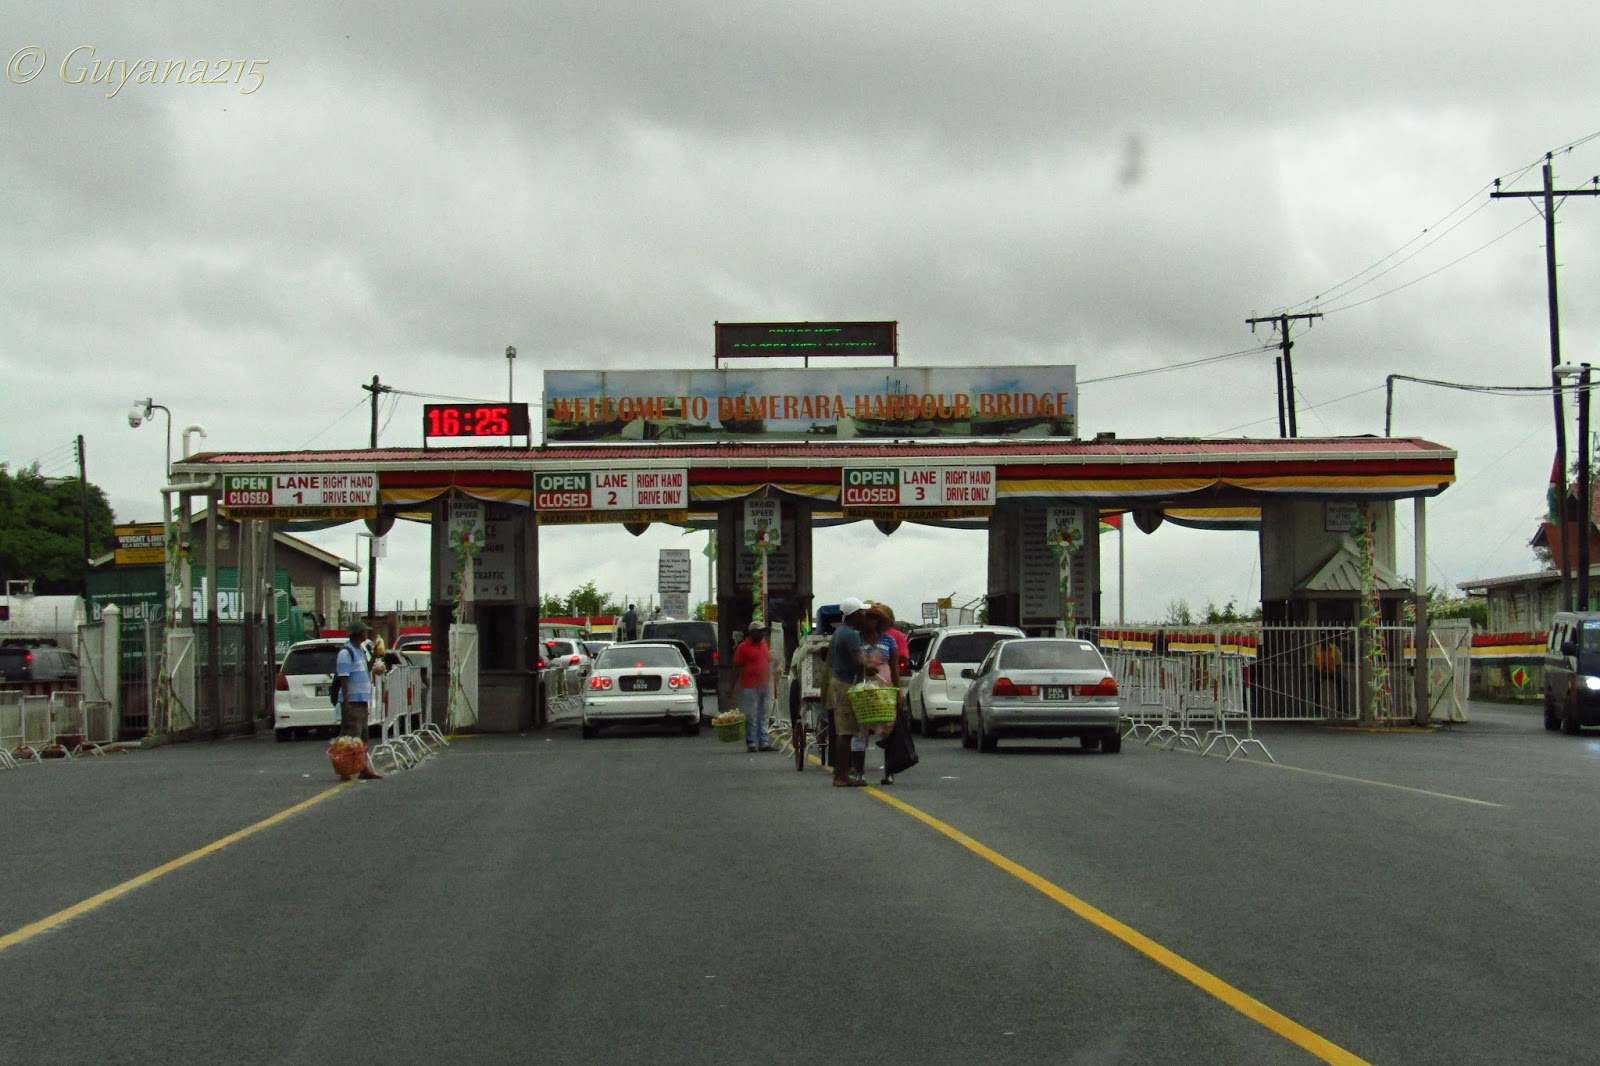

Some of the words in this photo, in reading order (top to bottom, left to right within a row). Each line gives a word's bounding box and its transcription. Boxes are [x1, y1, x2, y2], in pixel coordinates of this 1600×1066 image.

[552, 396, 668, 423] WELCOME
[677, 396, 708, 420] TO
[717, 394, 846, 421] DEMERARA
[854, 392, 970, 420] HARBOUR
[979, 391, 1071, 418] BRIDGE
[428, 407, 509, 436] 16:25
[231, 477, 267, 489] OPEN
[277, 477, 319, 489] LANE
[322, 476, 348, 489] RIGHT
[350, 476, 373, 489] HAND
[540, 476, 586, 490] OPEN
[596, 474, 628, 488] LANE
[637, 474, 659, 488] RIGHT
[661, 473, 682, 487] HAND
[849, 471, 895, 485] OPEN
[903, 471, 936, 485] LANE
[945, 471, 968, 485] RIGHT
[970, 471, 991, 485] HAND
[229, 492, 269, 504] CLOSED
[292, 491, 303, 504] 1
[322, 491, 348, 503] DRIVE
[350, 491, 371, 503] ONLY
[539, 493, 588, 507] CLOSED
[607, 491, 617, 505] 2
[638, 491, 660, 505] DRIVE
[662, 490, 681, 504] ONLY
[847, 488, 897, 502] CLOSED
[915, 487, 925, 501] 3
[946, 487, 969, 501] DRIVE
[971, 487, 990, 501] ONLY
[751, 509, 774, 517] SPEED
[1053, 508, 1076, 516] SPEED
